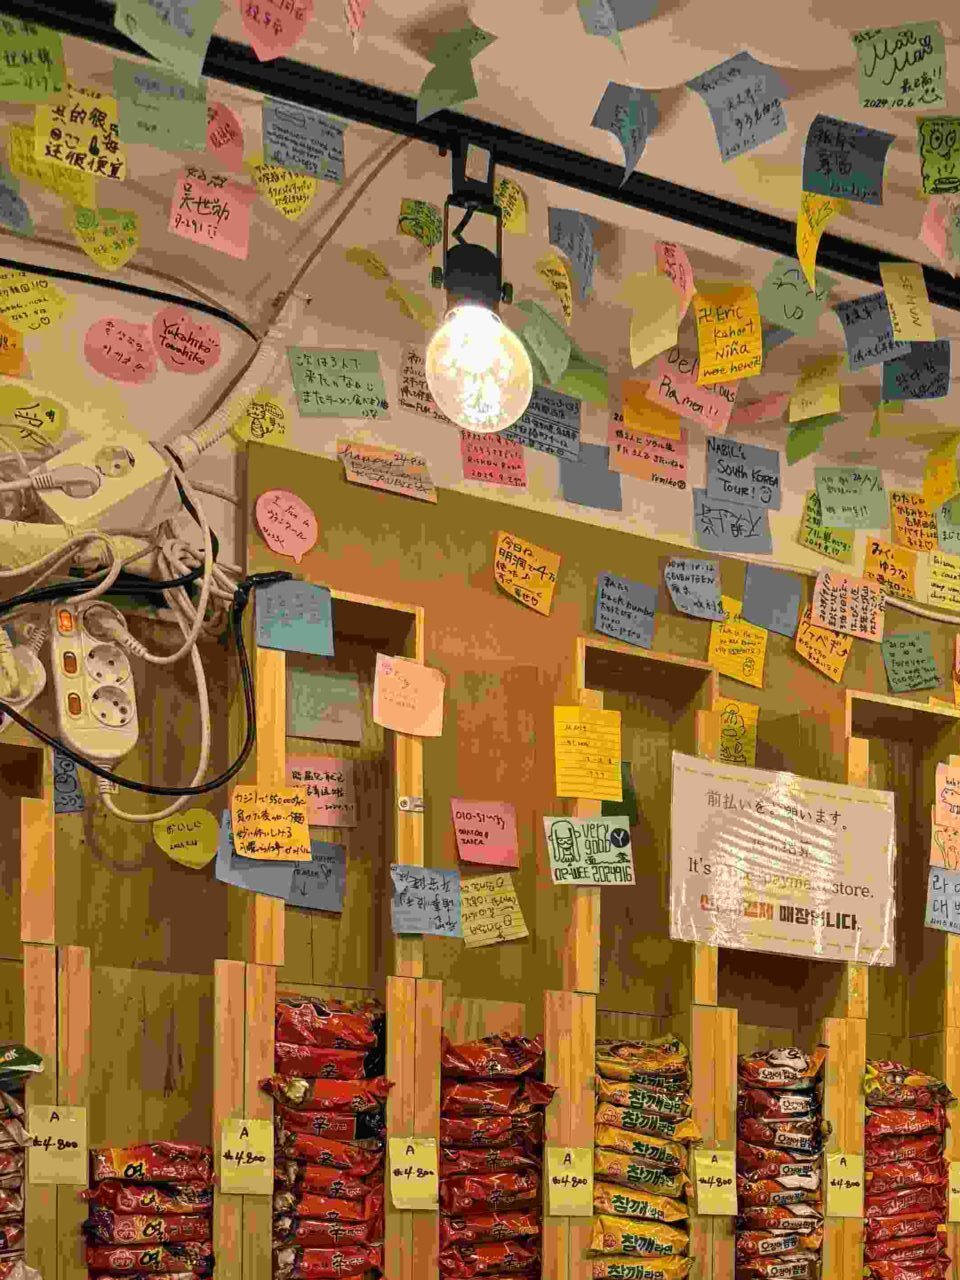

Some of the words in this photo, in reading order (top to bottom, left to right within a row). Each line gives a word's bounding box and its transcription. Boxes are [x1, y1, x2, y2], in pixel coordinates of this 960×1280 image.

[688, 857, 712, 875] It's
[831, 881, 875, 899] store.
[620, 1231, 674, 1257] 참깨라면
